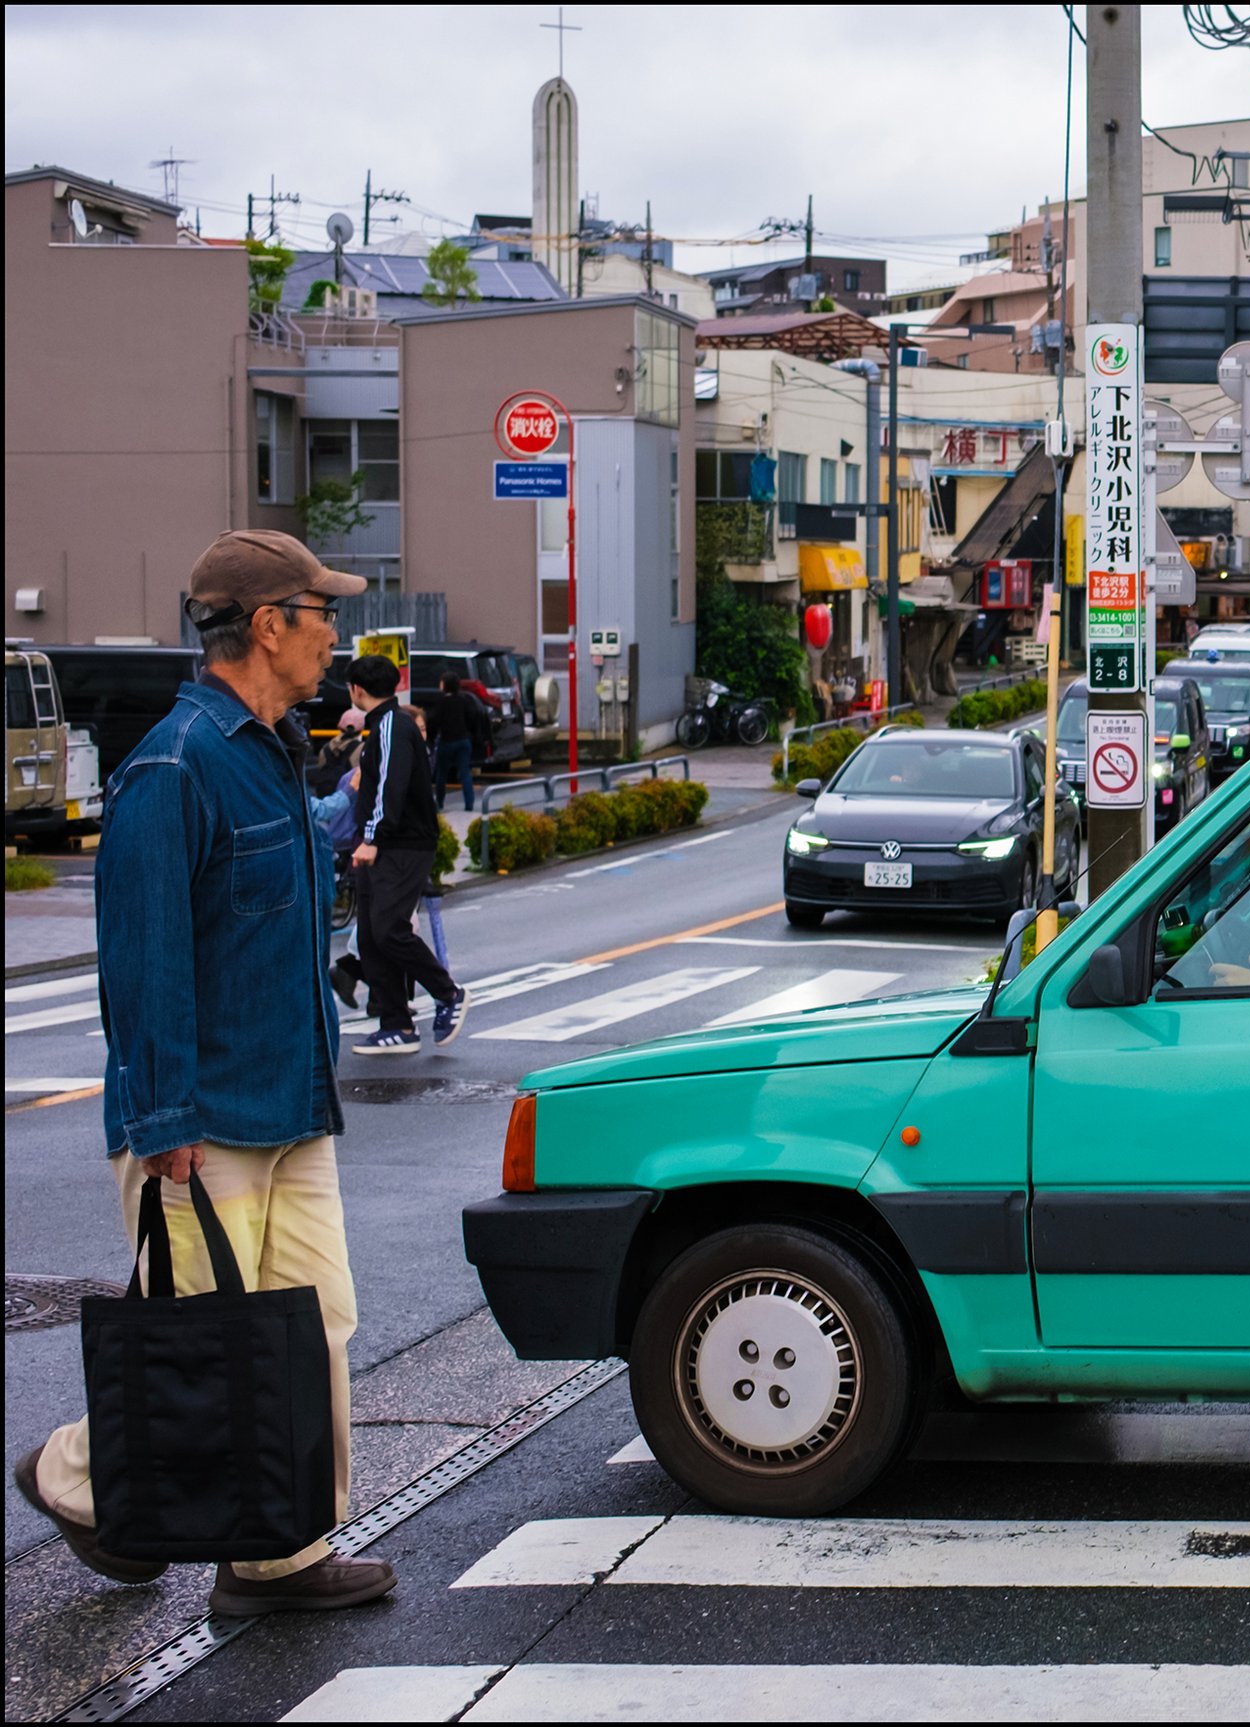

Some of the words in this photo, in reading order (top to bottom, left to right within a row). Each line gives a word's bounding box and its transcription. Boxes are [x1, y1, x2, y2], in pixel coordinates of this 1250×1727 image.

[510, 417, 554, 438] 消火栓
[942, 428, 1019, 465] 横丁
[499, 477, 535, 486] Panasonic
[537, 477, 562, 486] Homes
[1091, 387, 1102, 564] アレルギークリニック
[1106, 386, 1132, 563] 下北沢小児科
[875, 872, 909, 885] 25-25
